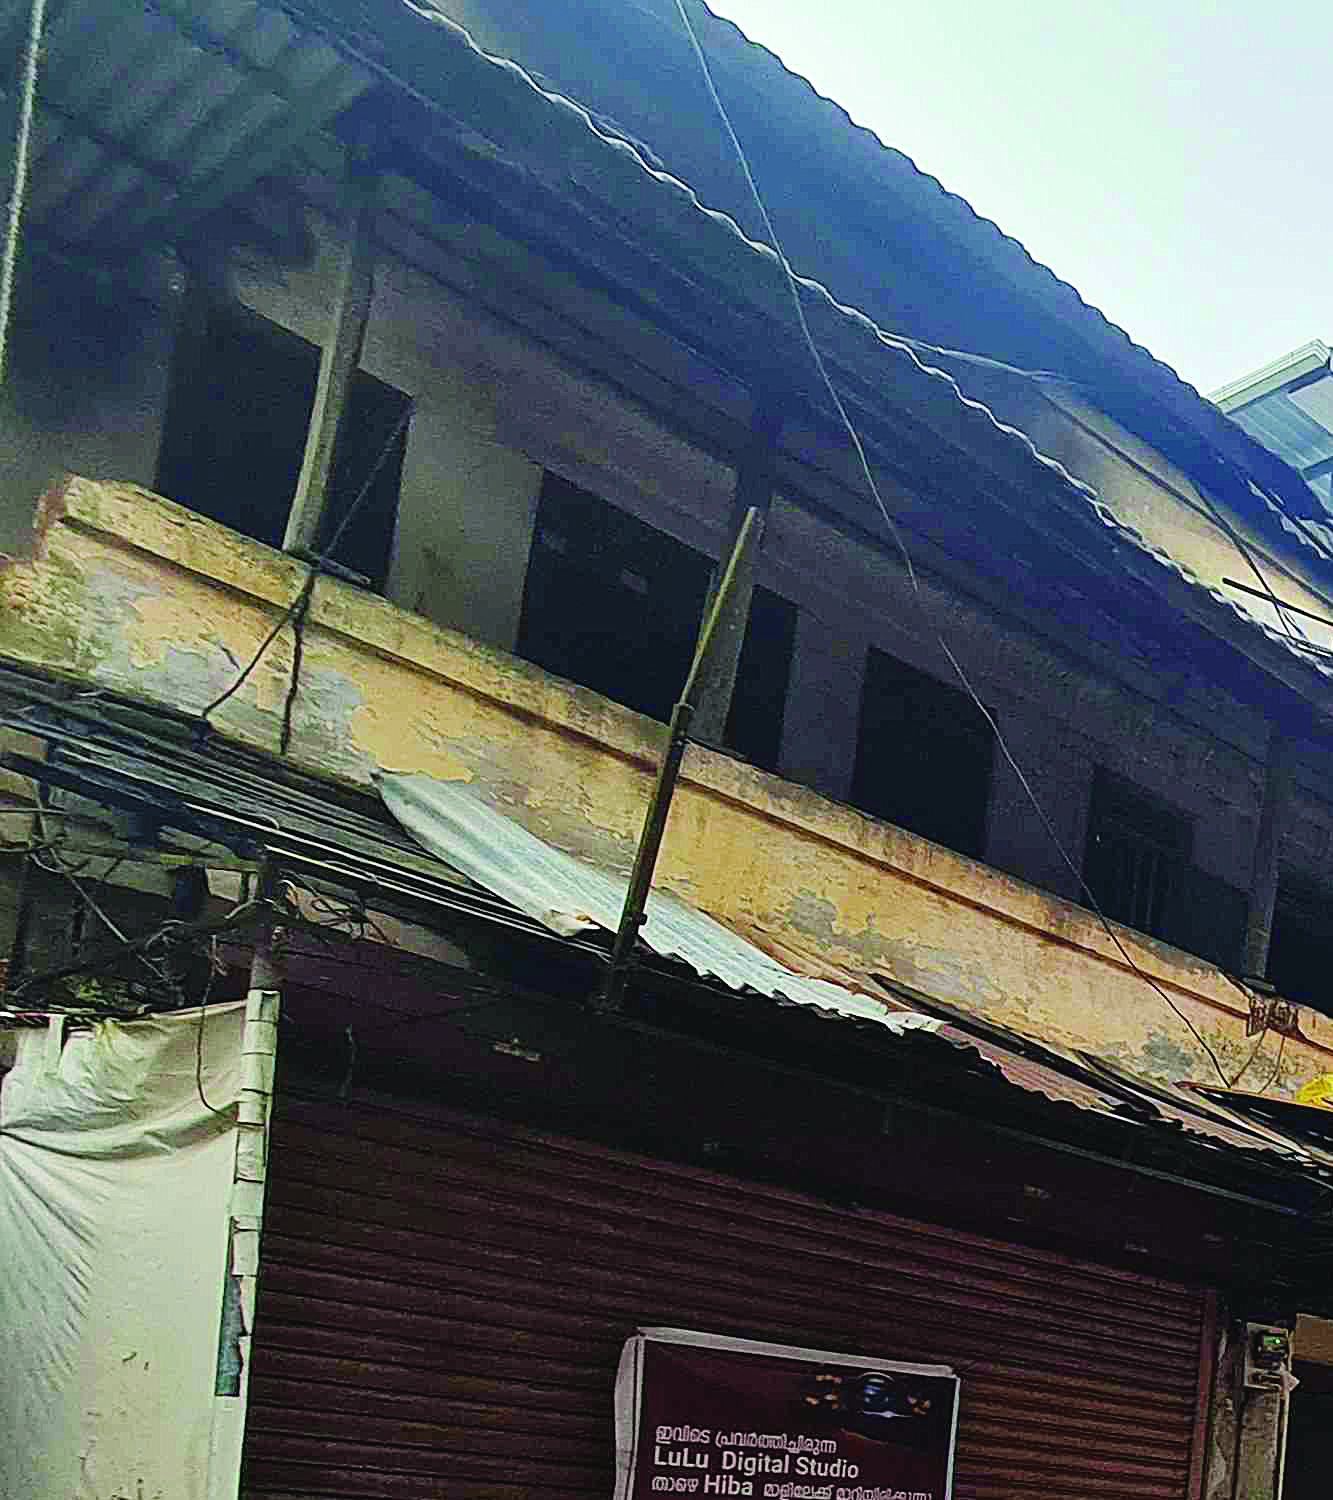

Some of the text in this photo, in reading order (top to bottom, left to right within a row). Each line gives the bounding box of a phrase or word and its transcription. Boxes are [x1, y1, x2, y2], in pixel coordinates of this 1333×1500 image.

[655, 1424, 712, 1445] ഇവിടെ
[654, 1445, 860, 1479] LuLu Digital Studio
[651, 1476, 700, 1493] താഴെ
[703, 1474, 753, 1496] Hiba
